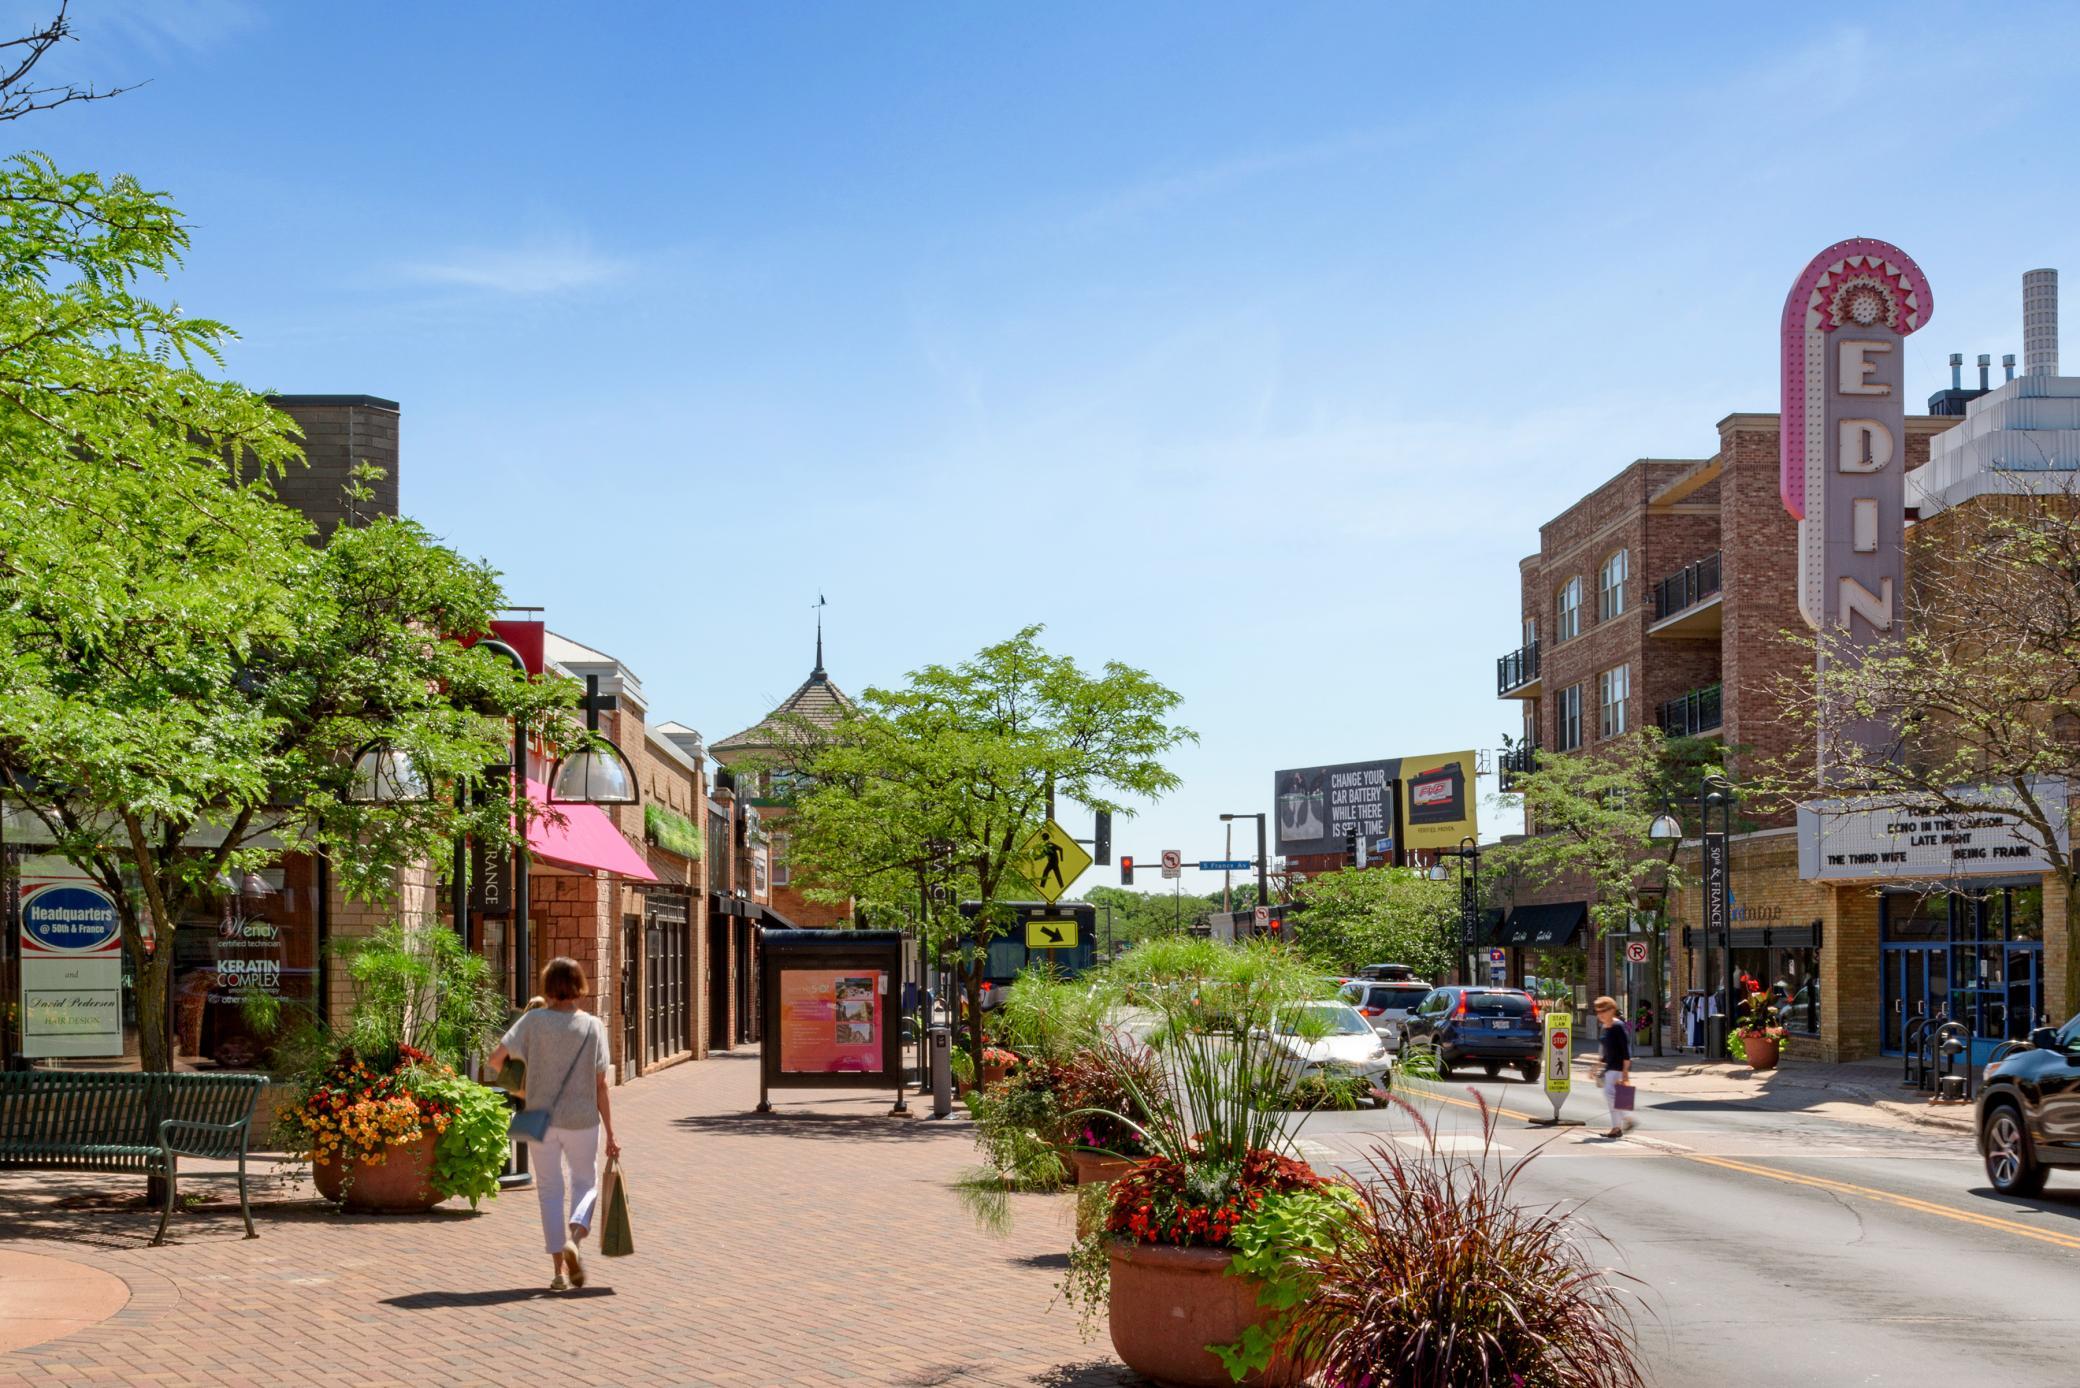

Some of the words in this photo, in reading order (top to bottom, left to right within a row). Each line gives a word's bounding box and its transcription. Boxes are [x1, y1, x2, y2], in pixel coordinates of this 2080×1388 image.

[1838, 340, 1894, 645] EDIN
[1332, 773, 1362, 788] CHANGE
[1364, 769, 1385, 785] YOUR
[1332, 789, 1346, 804] CAR
[1348, 787, 1381, 803] BATTERY
[1332, 805, 1356, 821] WHILE
[1358, 803, 1382, 819] THERE
[1332, 823, 1341, 838] IS
[1887, 823, 1917, 834] ECHO
[1921, 822, 1932, 832] IN
[1934, 821, 1954, 831] THE
[1910, 835, 1937, 846] LATE
[1827, 854, 1845, 865] THE
[1848, 853, 1879, 864] THIRD
[1881, 852, 1907, 862] WIFE
[1953, 848, 1986, 860] BEING
[1993, 846, 2031, 857] FRANK
[1710, 867, 1721, 880] &
[1711, 882, 1722, 927] FRANCE
[31, 905, 113, 922] Headquarters
[51, 923, 69, 933] 50th
[70, 923, 78, 933] &
[78, 923, 104, 934] France
[220, 913, 279, 940] Wendy
[1466, 910, 1474, 942] FRANCE
[217, 960, 280, 973] KERATIN
[64, 970, 79, 979] and
[217, 973, 280, 987] COMPLEX
[31, 998, 65, 1009] David
[68, 1016, 100, 1025] DESIGN
